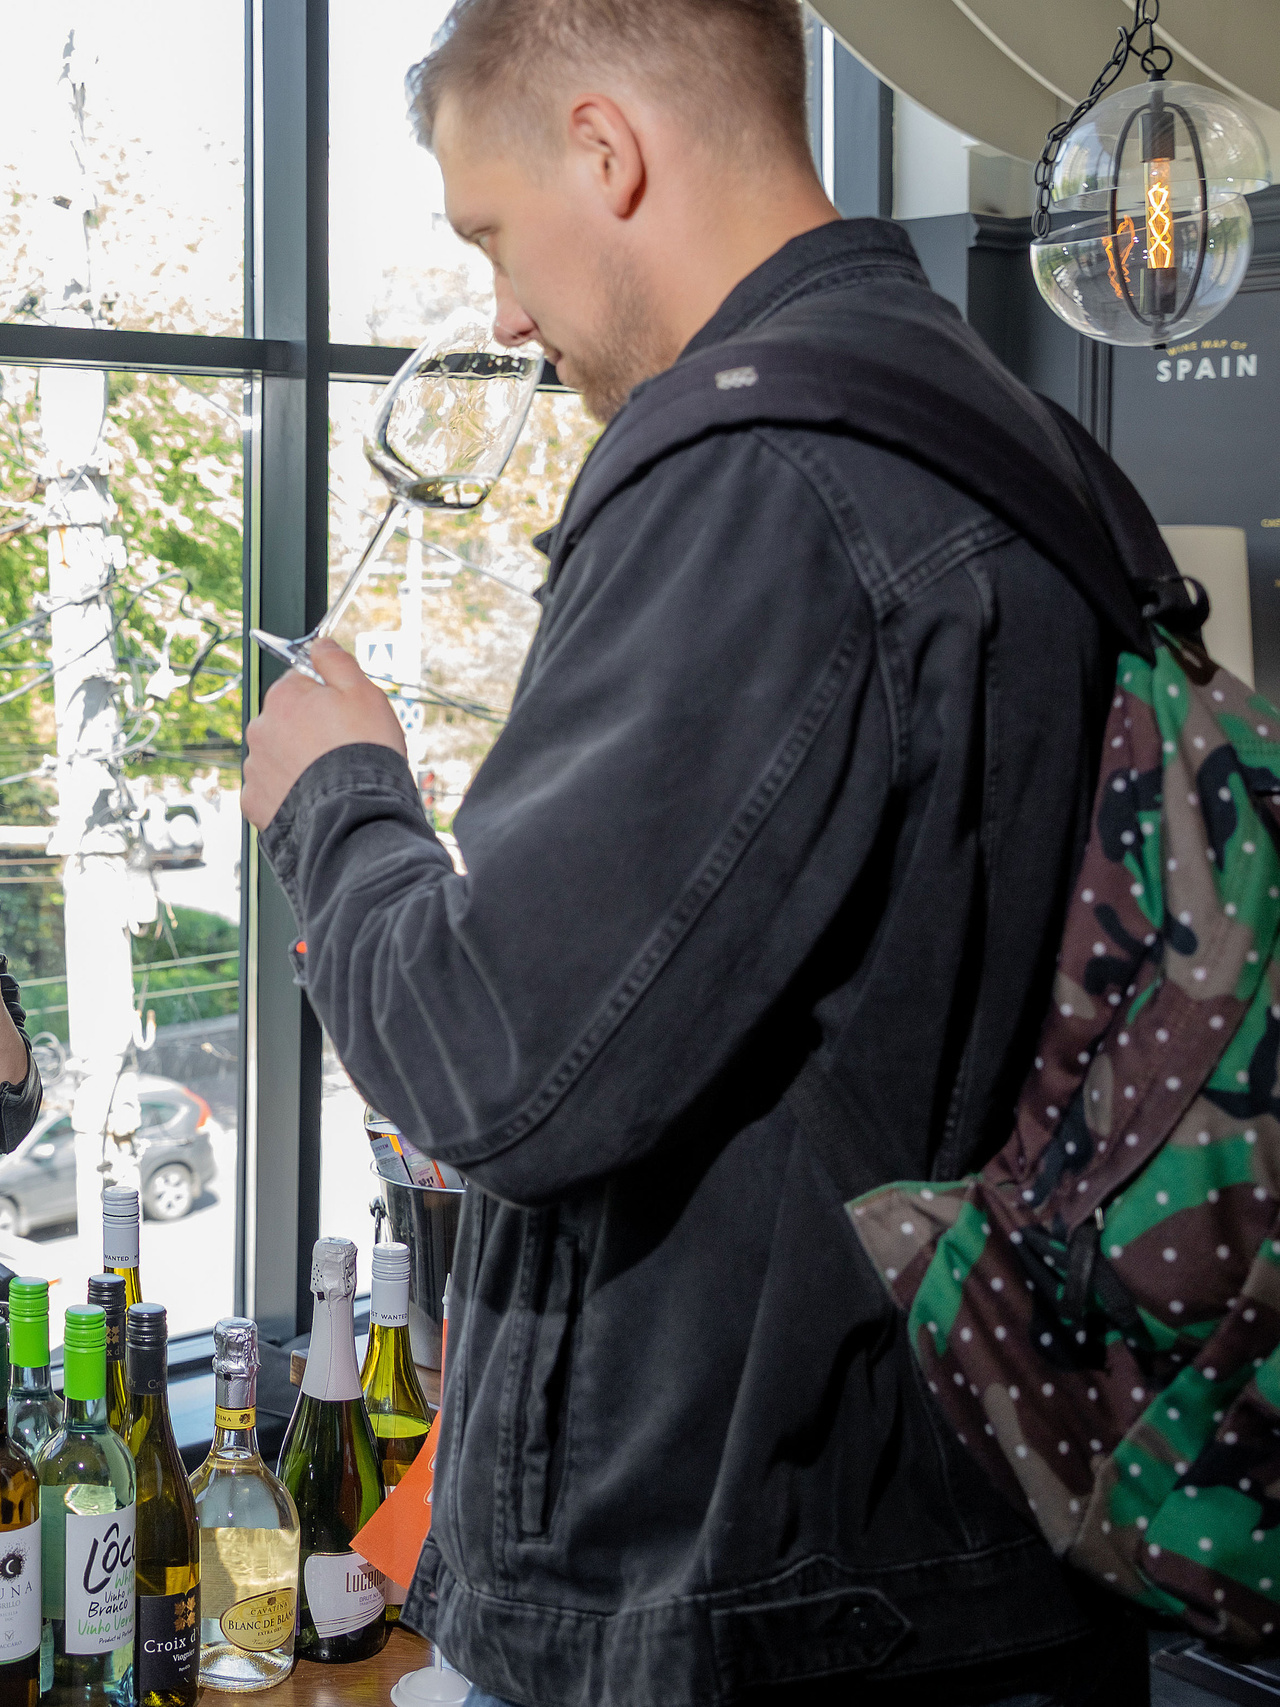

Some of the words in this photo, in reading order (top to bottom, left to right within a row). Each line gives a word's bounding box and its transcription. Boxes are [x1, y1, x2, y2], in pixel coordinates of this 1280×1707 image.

[1156, 354, 1258, 382] SPAIN
[105, 1588, 125, 1604] Vinho
[88, 1598, 129, 1618] Branco
[250, 1601, 288, 1616] CAVATINA
[78, 1617, 111, 1636] Vinho
[228, 1620, 262, 1631] BLANC
[264, 1617, 275, 1629] DE
[143, 1636, 187, 1654] Croix
